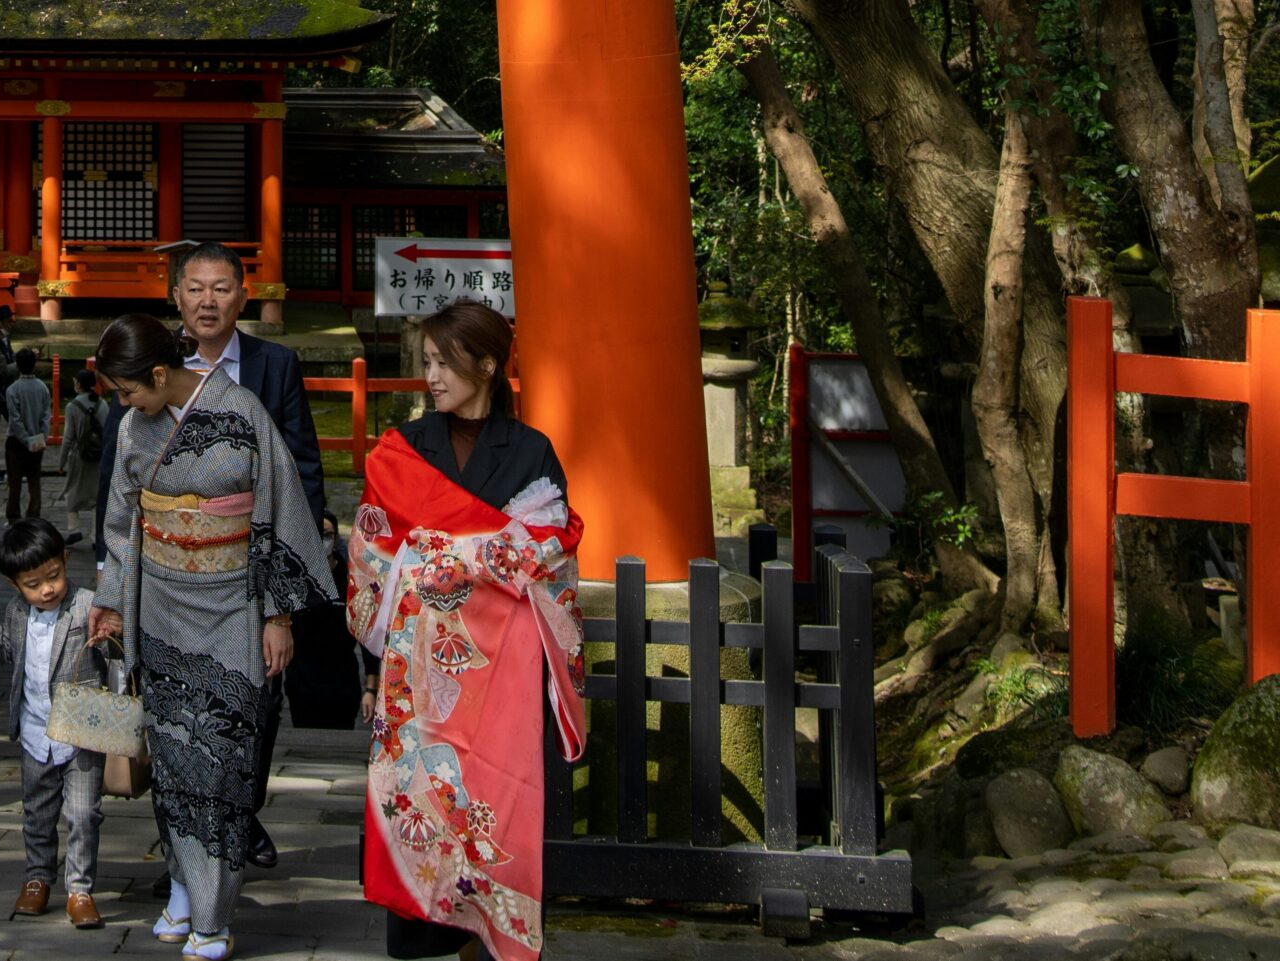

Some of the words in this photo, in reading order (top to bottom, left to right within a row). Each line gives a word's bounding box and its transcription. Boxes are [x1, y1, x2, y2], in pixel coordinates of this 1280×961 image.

[389, 268, 513, 292] お帰り順路
